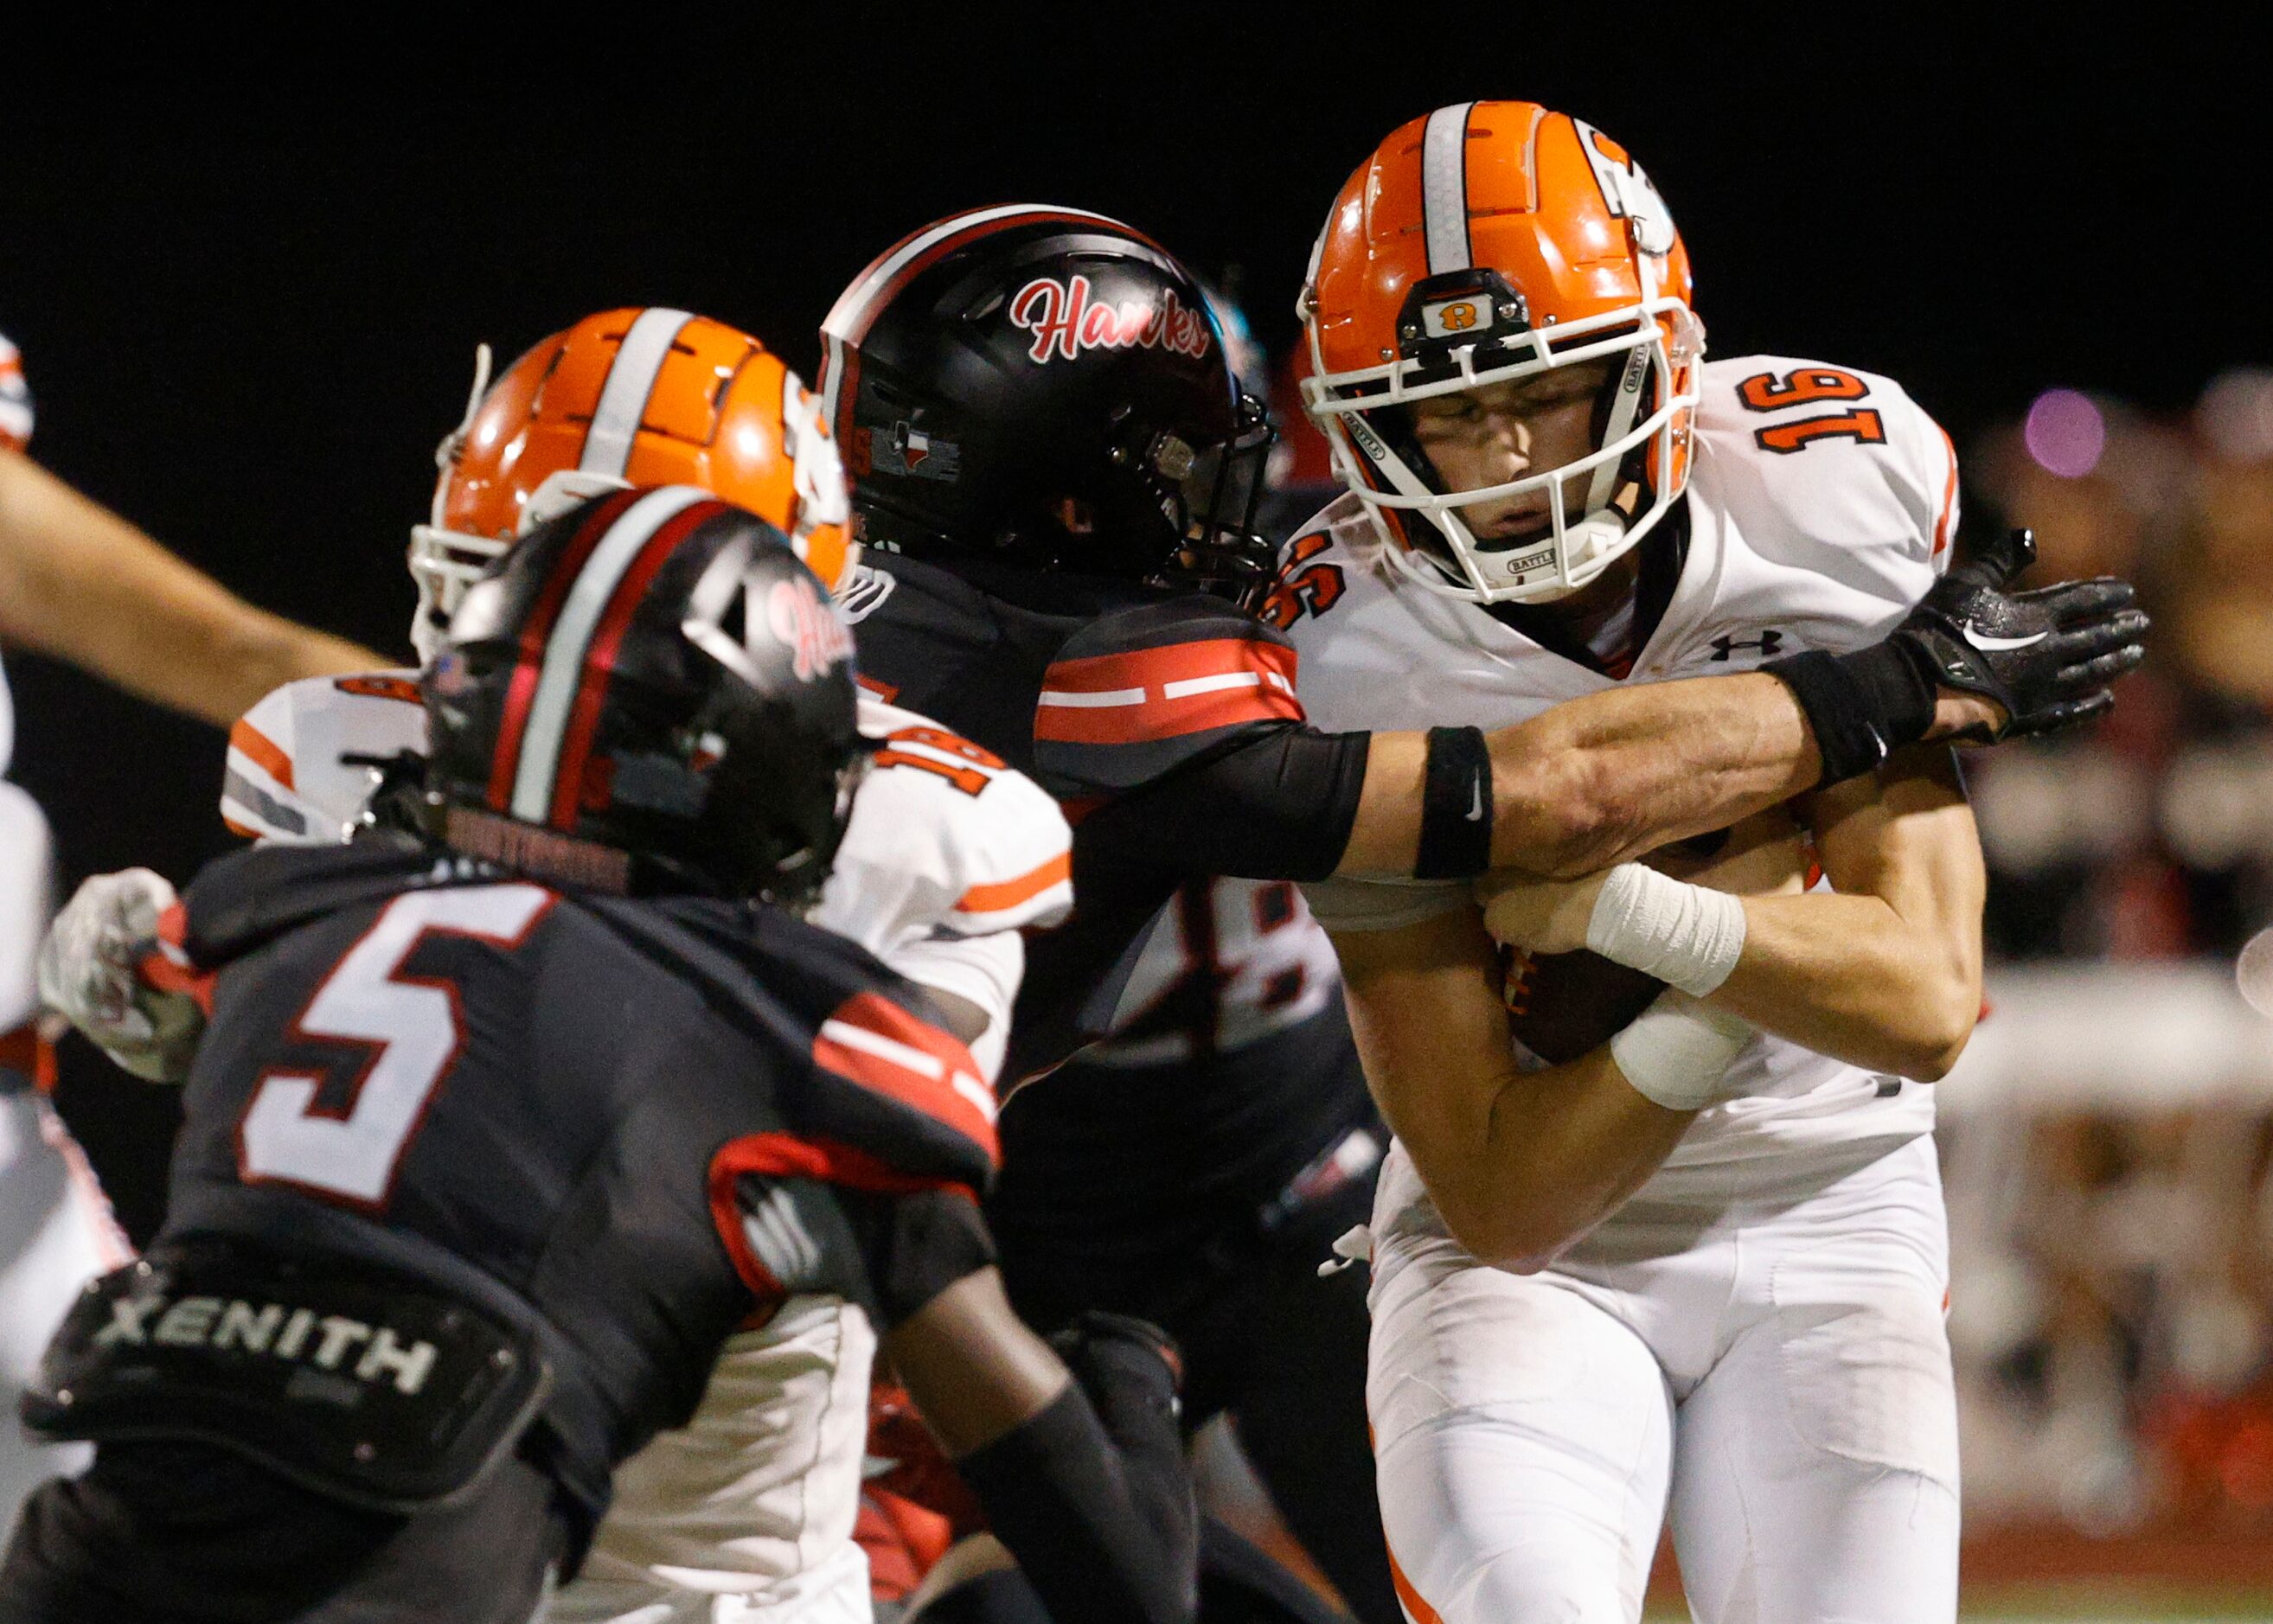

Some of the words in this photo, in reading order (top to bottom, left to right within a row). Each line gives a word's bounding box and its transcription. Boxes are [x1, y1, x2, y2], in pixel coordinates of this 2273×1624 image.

[1008, 275, 1209, 364] Hawks
[1438, 303, 1477, 339] R
[1734, 368, 1888, 455] 16
[238, 879, 564, 1216] 5
[93, 1295, 438, 1396] XENITH
